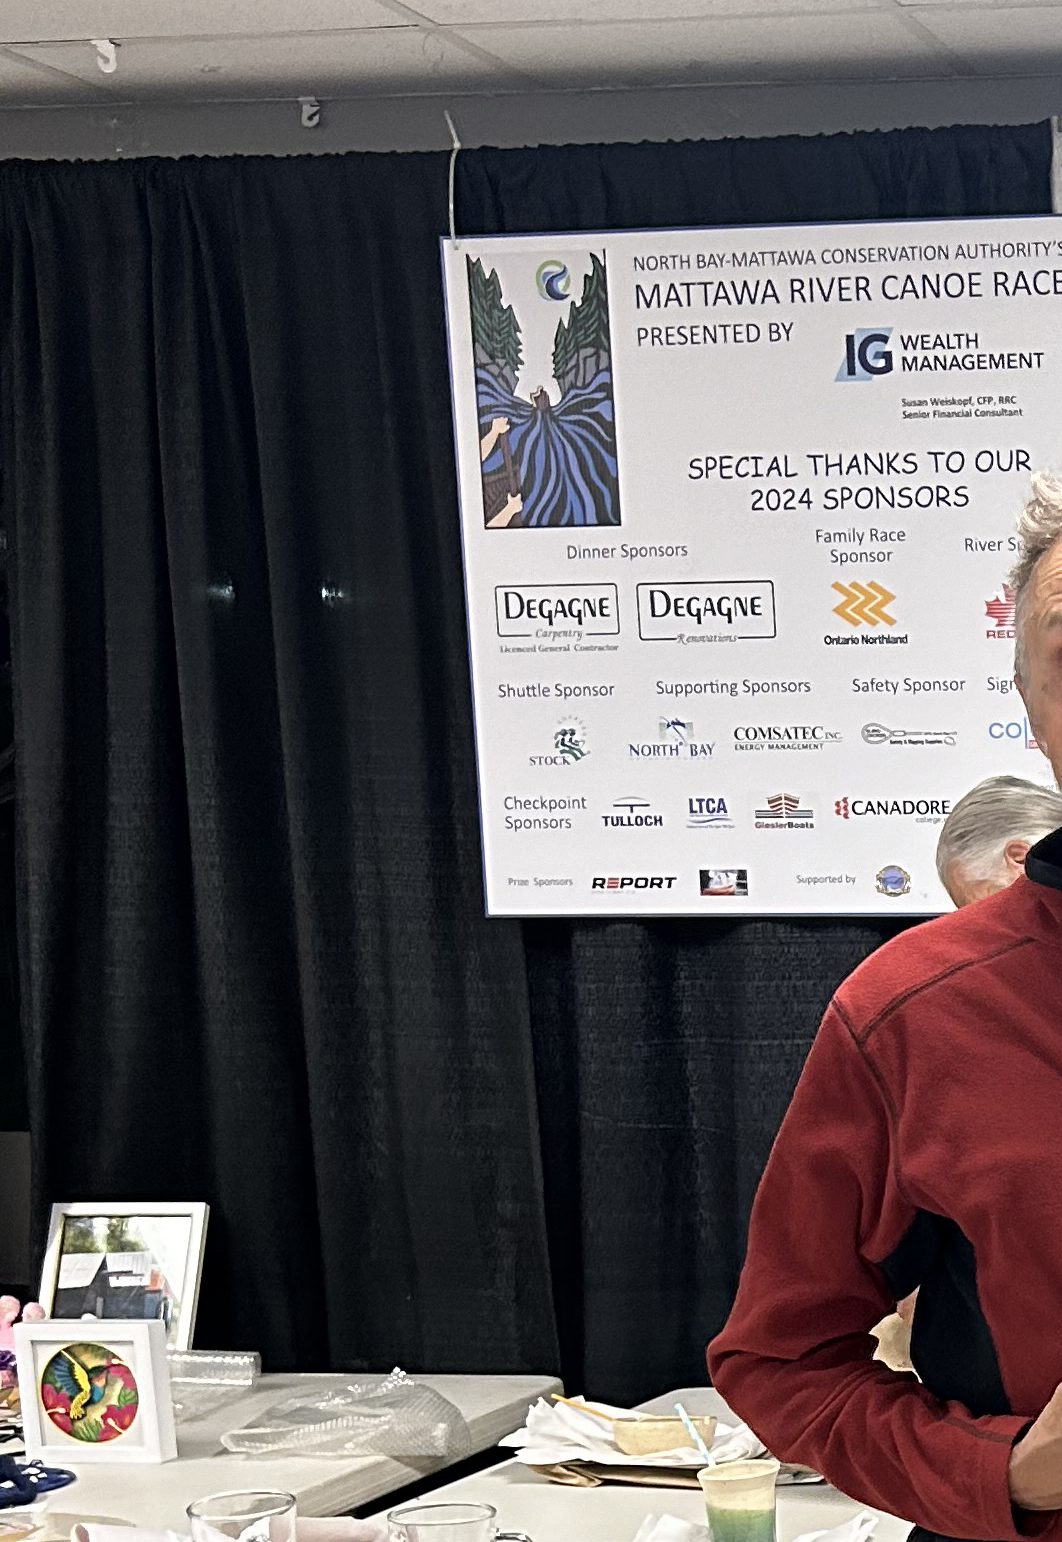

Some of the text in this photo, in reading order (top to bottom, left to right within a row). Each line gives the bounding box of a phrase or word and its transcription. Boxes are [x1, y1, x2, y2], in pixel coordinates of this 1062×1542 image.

[633, 254, 691, 272] NORTH
[696, 249, 817, 270] BAY-MATTAWA
[821, 244, 949, 265] CONSERVATION
[635, 278, 781, 309] MATTAWA
[790, 275, 872, 304] RIVER
[881, 272, 983, 301] CANOE
[637, 321, 794, 346] PRESENTED BY
[900, 332, 979, 351] WEALTH
[845, 332, 894, 377] IG
[901, 352, 1045, 372] MANAGEMENT
[901, 397, 928, 407] Susan
[902, 407, 1024, 420] Senior Financial Consultant
[688, 449, 1033, 480] SPECIAL THANKS TO OUR
[750, 485, 970, 512] 2024 SPONSORS
[815, 528, 907, 546] Family Race
[964, 537, 1004, 552] River
[567, 543, 689, 561] Dinner Sponsors
[830, 549, 894, 566] Sponsor
[824, 633, 909, 646] Ontario Northland
[498, 682, 616, 701] Shuttle Sponsor
[656, 679, 812, 697] Supporting Sponsors
[852, 677, 967, 695] Safety Sponsor
[733, 725, 824, 742] COMSATEC
[629, 742, 717, 758] NORTH BAY
[734, 742, 824, 752] ENERGY MANAGEMENT
[529, 755, 571, 766] STOCK
[504, 796, 588, 813] Checkpoint
[689, 797, 729, 814] LTCA
[851, 799, 951, 816] CANADORE
[504, 816, 572, 832] Sponsors
[601, 815, 663, 827] TULLOCH
[507, 877, 574, 888] Prize Sponsors
[591, 876, 678, 890] REPORT
[796, 874, 857, 886] Supported by
